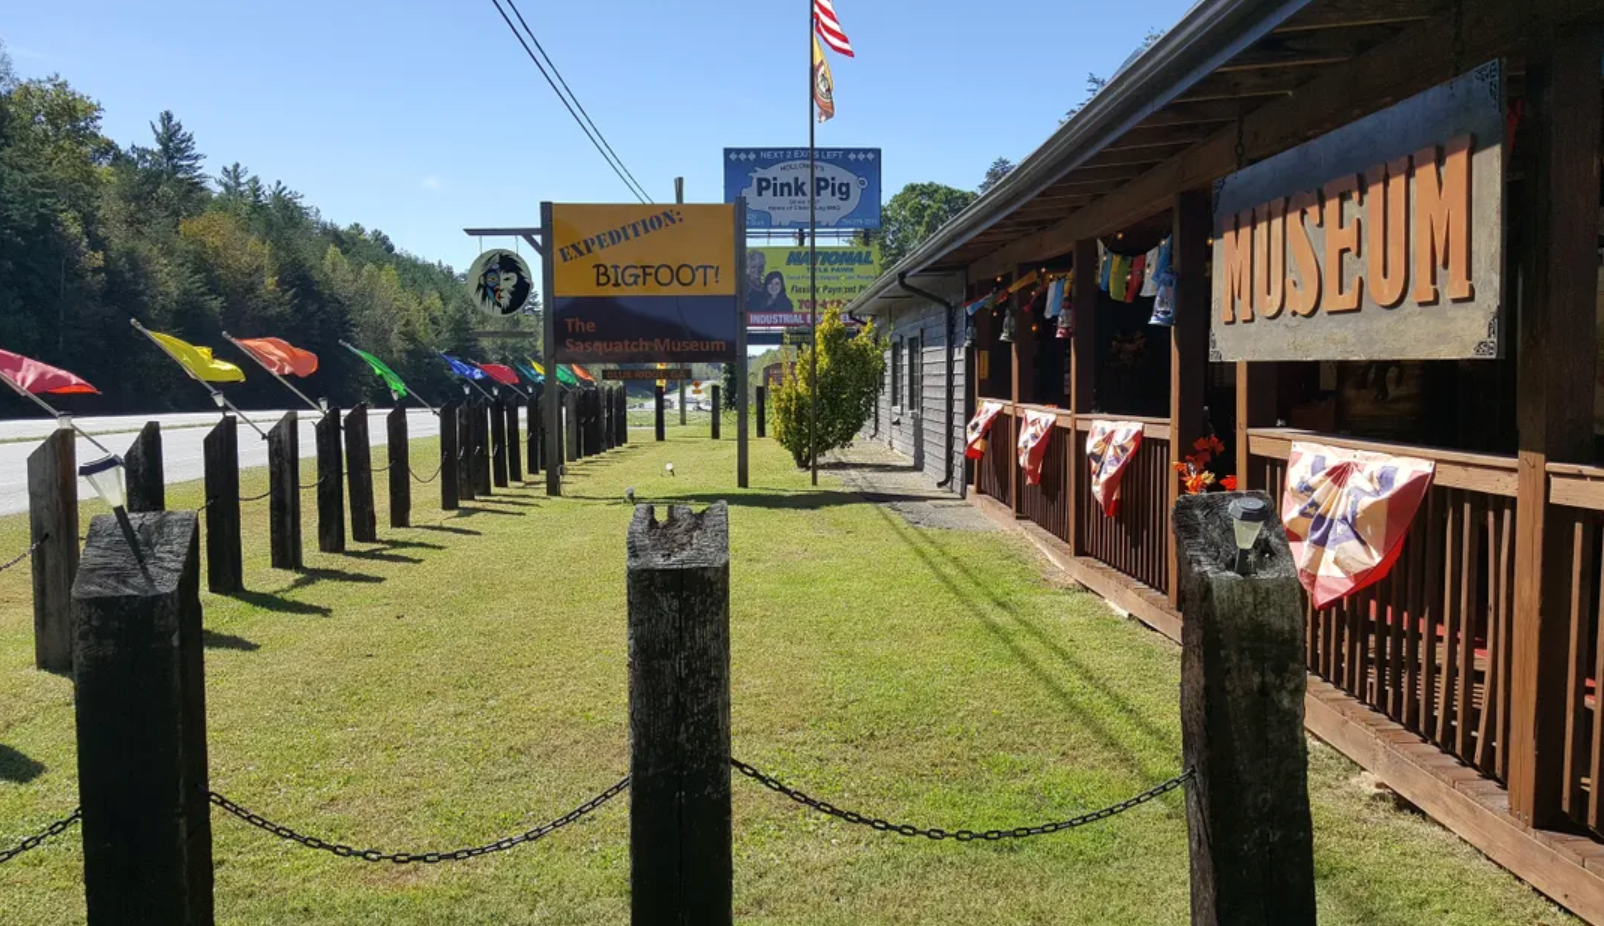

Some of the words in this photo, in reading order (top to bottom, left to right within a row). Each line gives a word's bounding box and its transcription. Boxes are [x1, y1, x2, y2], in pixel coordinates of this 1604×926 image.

[760, 151, 784, 159] NEXT
[786, 151, 792, 159] 2
[794, 150, 819, 159] EXIS
[821, 151, 844, 159] LEFT
[756, 176, 807, 198] Pink
[815, 176, 851, 202] Pig
[558, 208, 684, 264] EXPEDITION:
[1220, 134, 1475, 325] MUSEUM
[786, 251, 874, 265] NATIONAL
[593, 263, 720, 288] BIGFOOT!
[565, 318, 596, 333] The
[750, 314, 804, 324] INDUSTRIAL
[565, 337, 649, 354] Sasquatch
[655, 338, 726, 352] Museum
